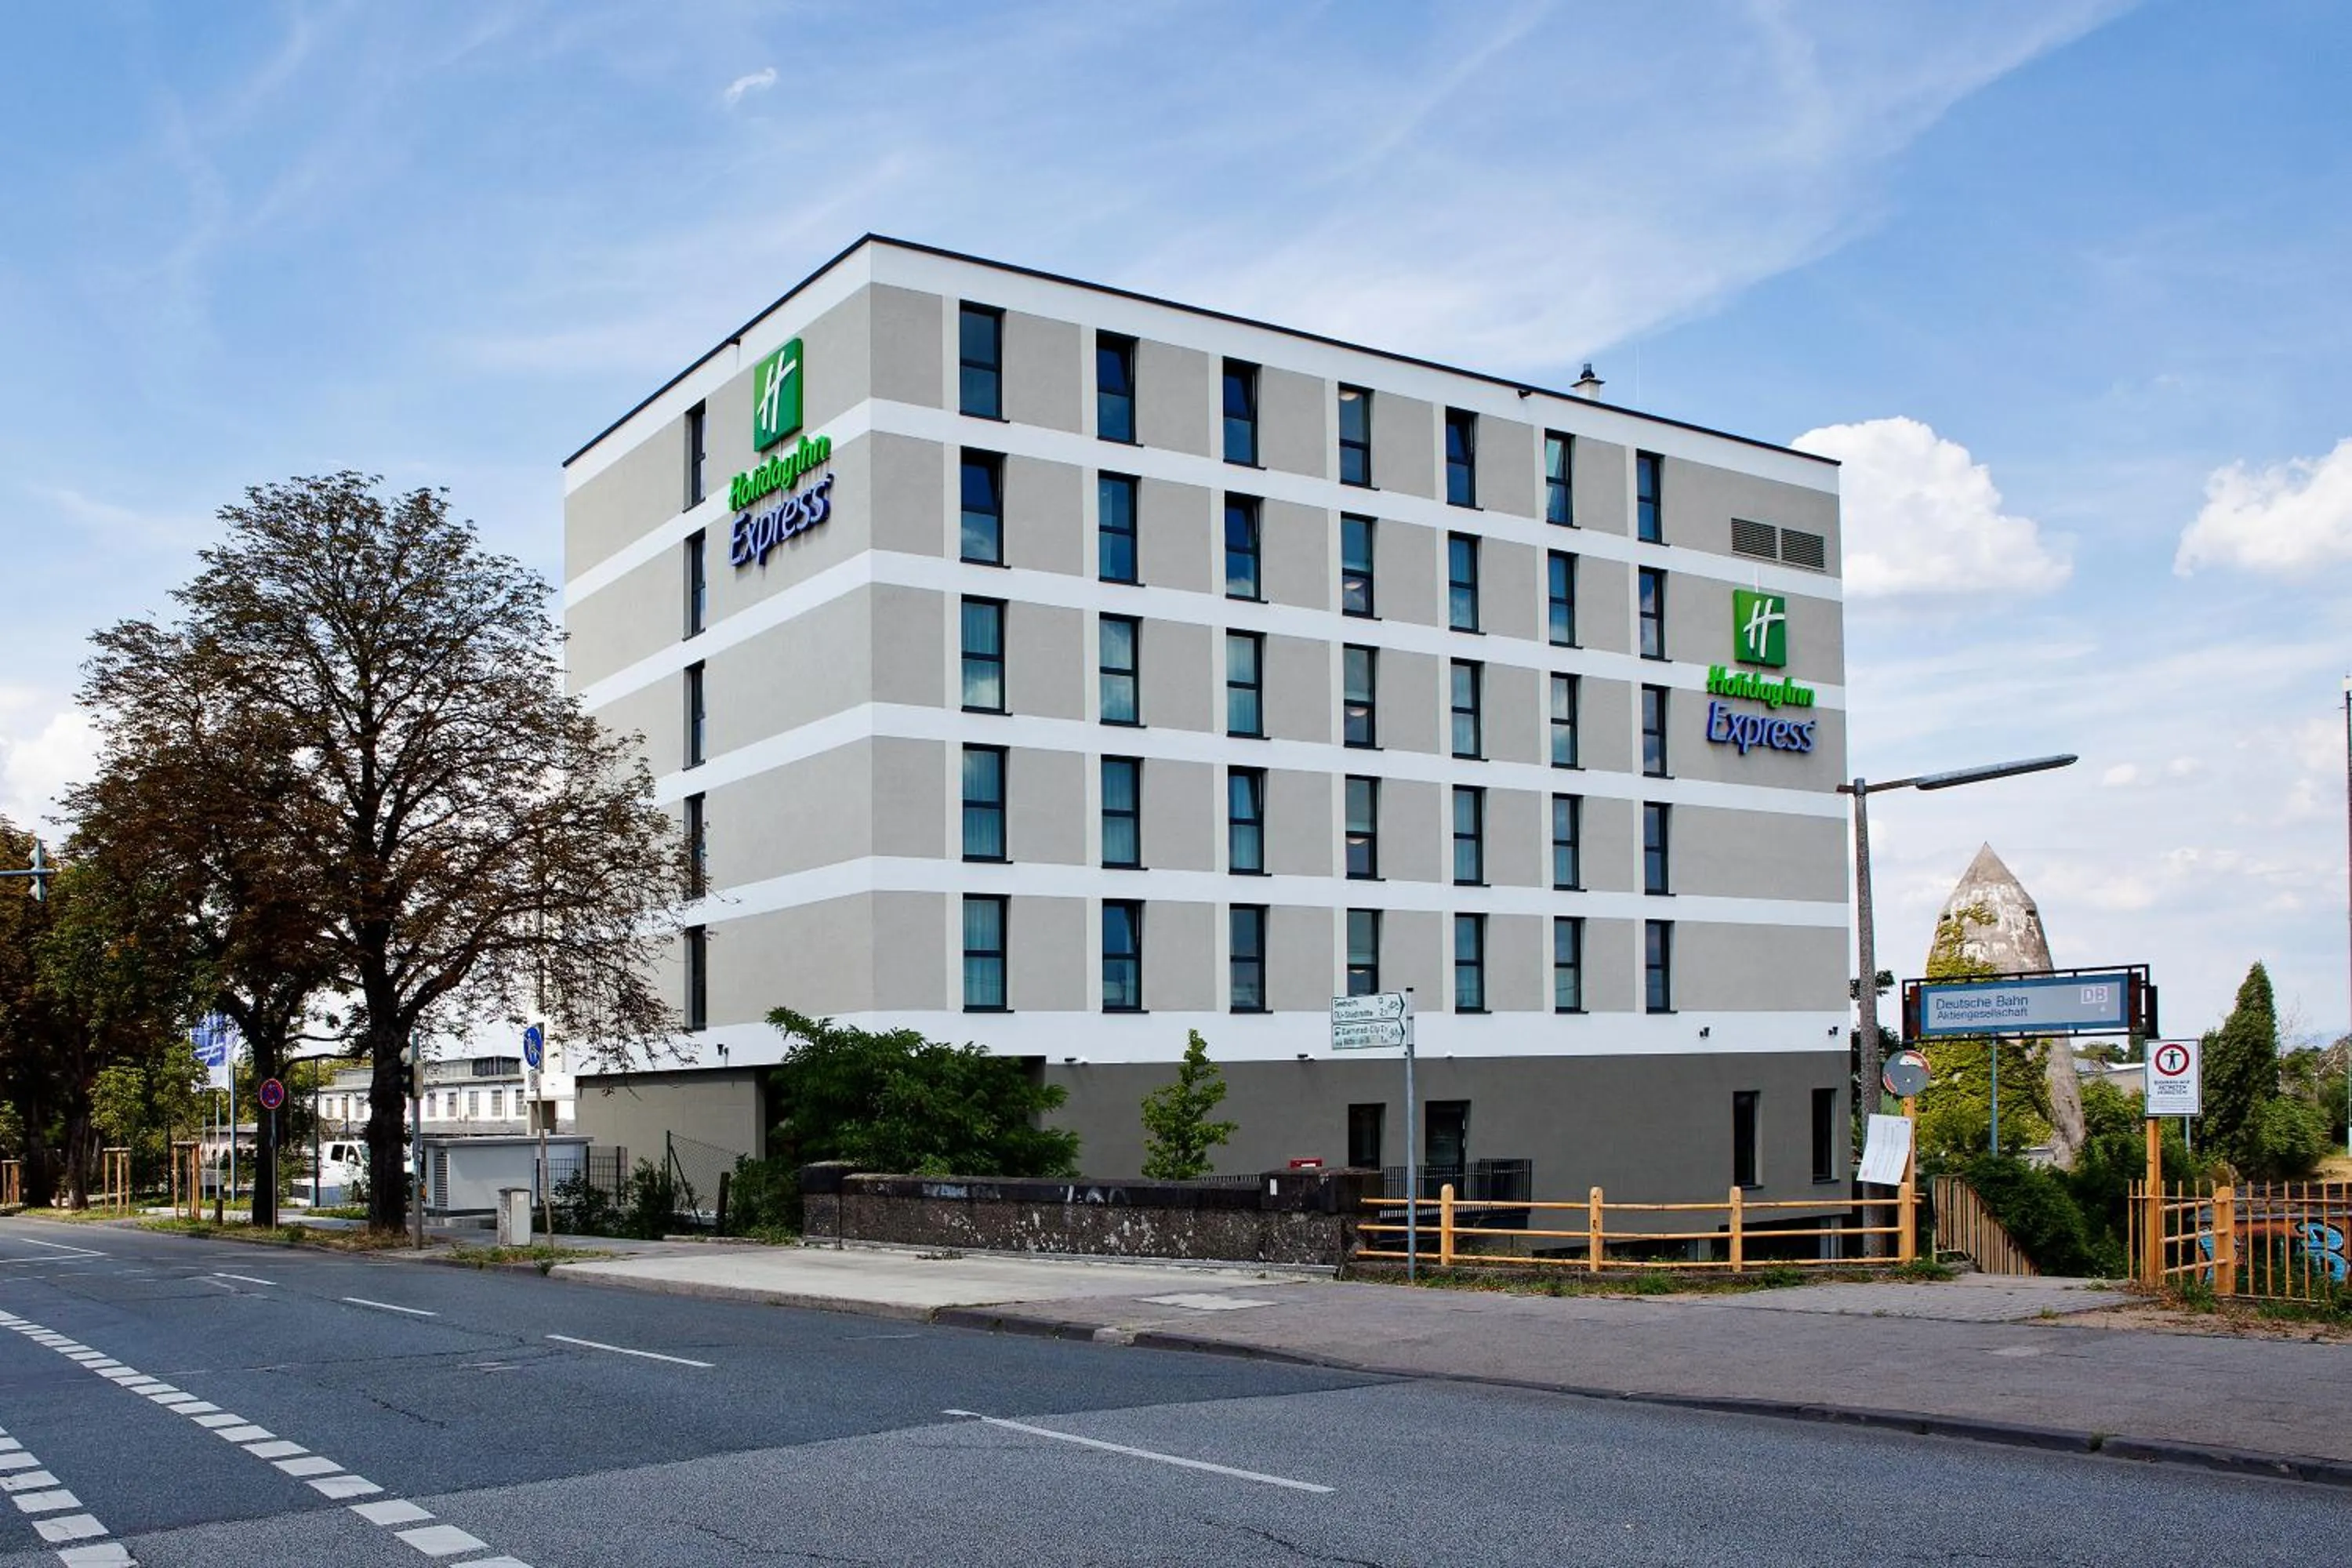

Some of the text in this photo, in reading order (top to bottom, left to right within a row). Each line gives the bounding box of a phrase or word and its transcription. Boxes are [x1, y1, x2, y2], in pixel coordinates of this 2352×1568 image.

[729, 435, 831, 511] Holiday Inn
[729, 481, 831, 566] Express
[1706, 665, 1815, 709] Holiday Inn
[1706, 701, 1814, 756] Express
[1935, 994, 2029, 1011] Deutsche Bahn
[1936, 1007, 2029, 1022] Aktiengesellschaft
[2082, 987, 2107, 1003] DB
